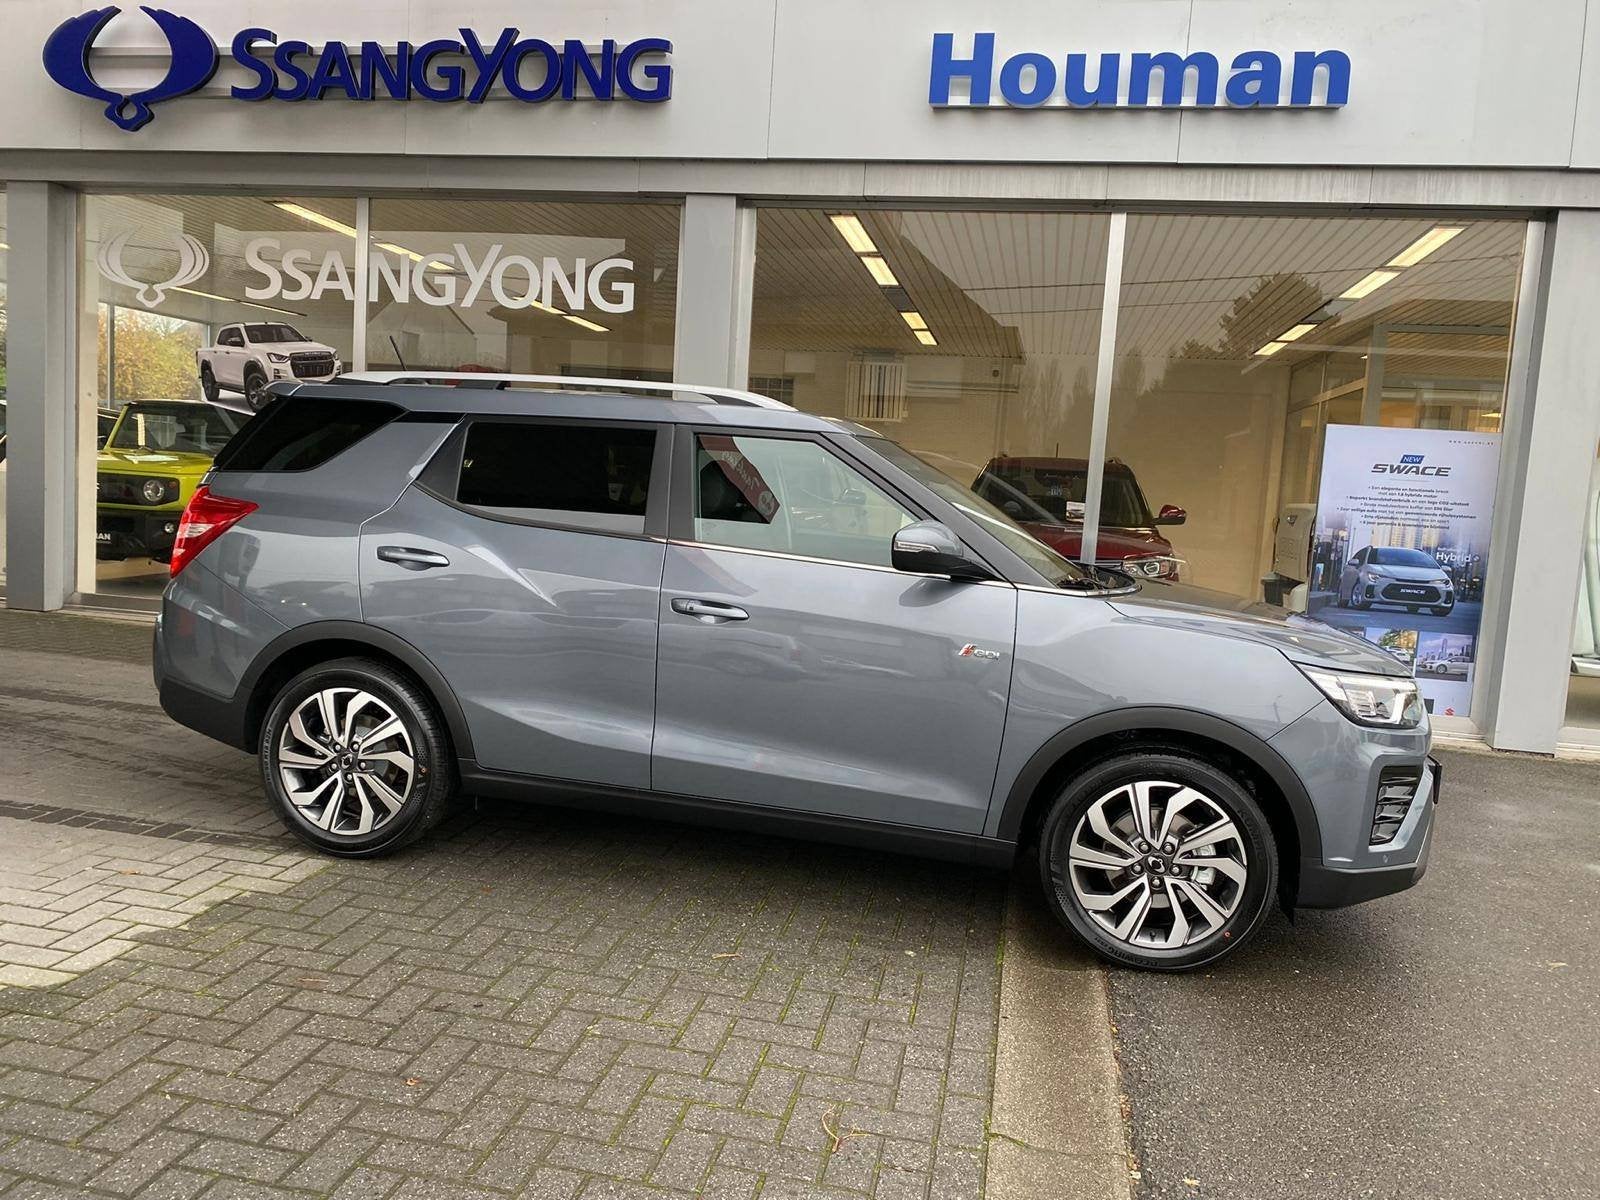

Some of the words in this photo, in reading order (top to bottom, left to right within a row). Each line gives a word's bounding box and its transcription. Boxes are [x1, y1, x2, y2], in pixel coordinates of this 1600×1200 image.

[929, 32, 1352, 109] Houman
[1402, 456, 1422, 464] NEW
[1371, 463, 1452, 477] SWACE
[1436, 552, 1472, 564] Hybrid
